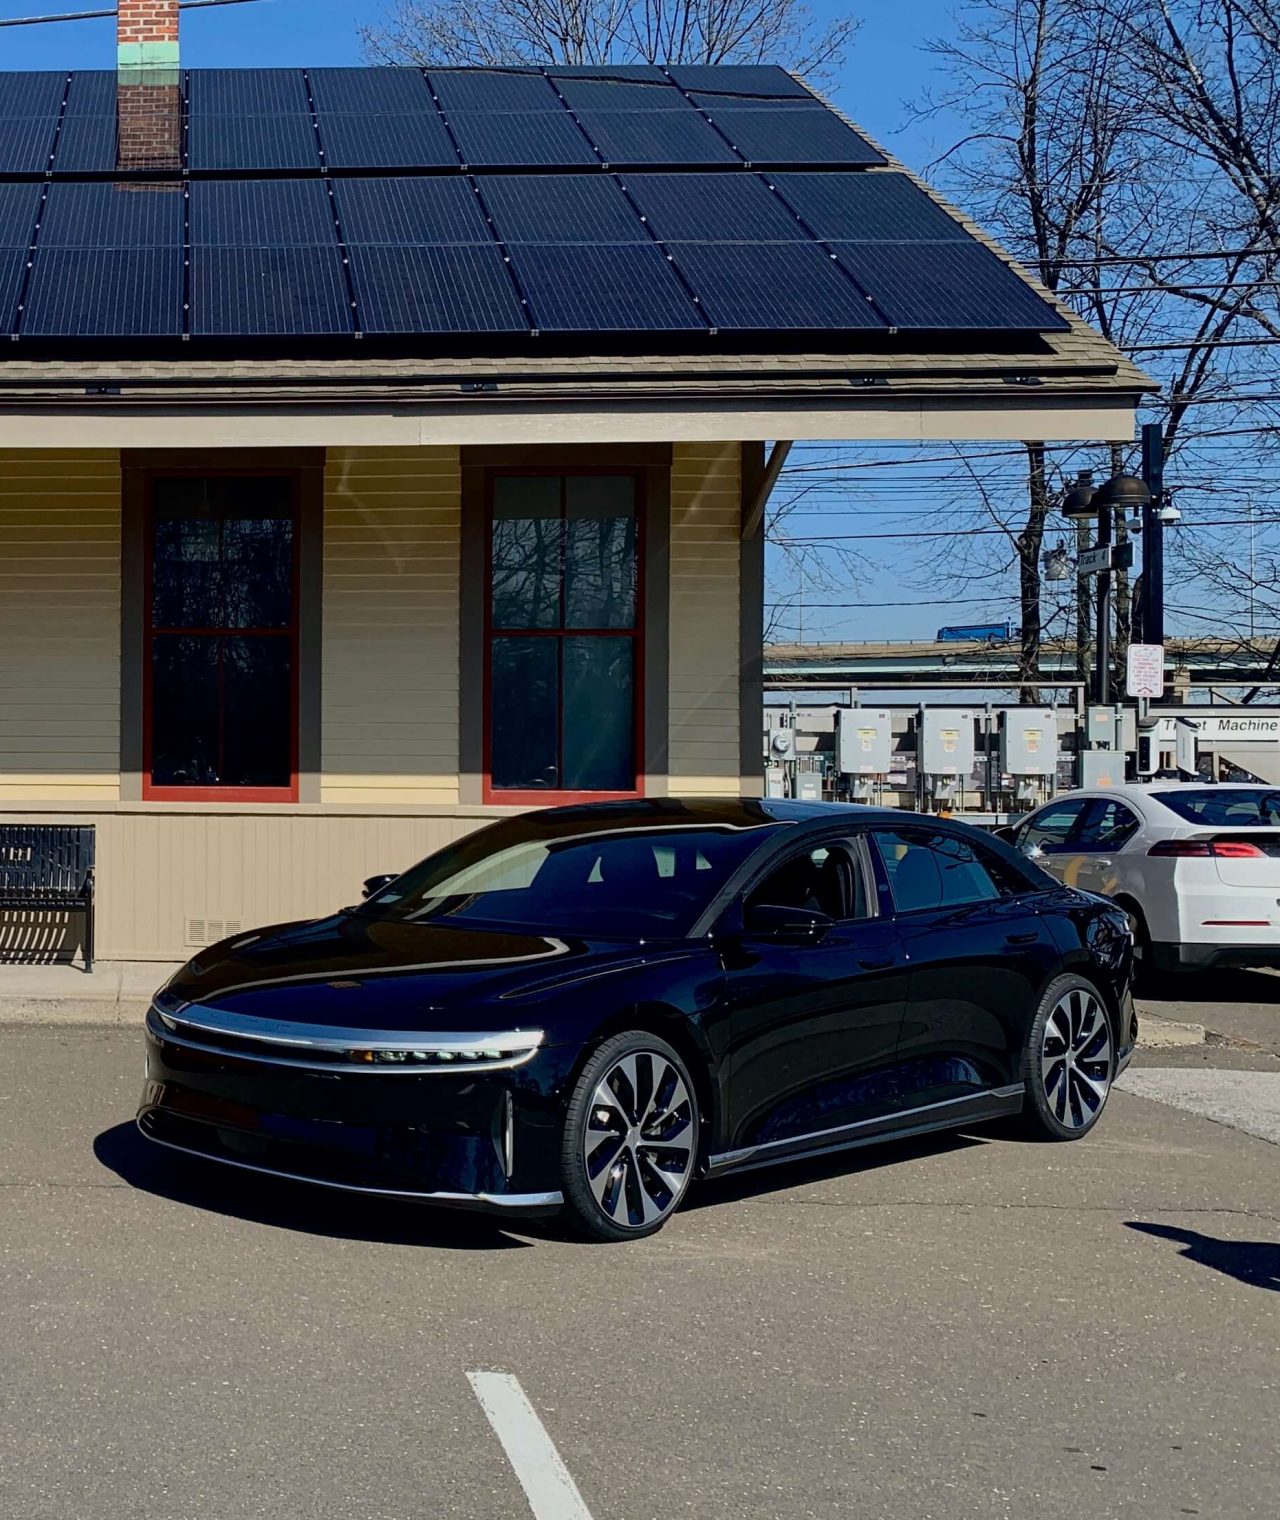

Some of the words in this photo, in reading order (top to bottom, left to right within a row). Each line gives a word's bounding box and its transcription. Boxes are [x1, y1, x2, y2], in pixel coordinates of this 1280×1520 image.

[1080, 552, 1097, 566] Track
[1164, 719, 1207, 731] Tiet
[1218, 719, 1278, 731] Machine
